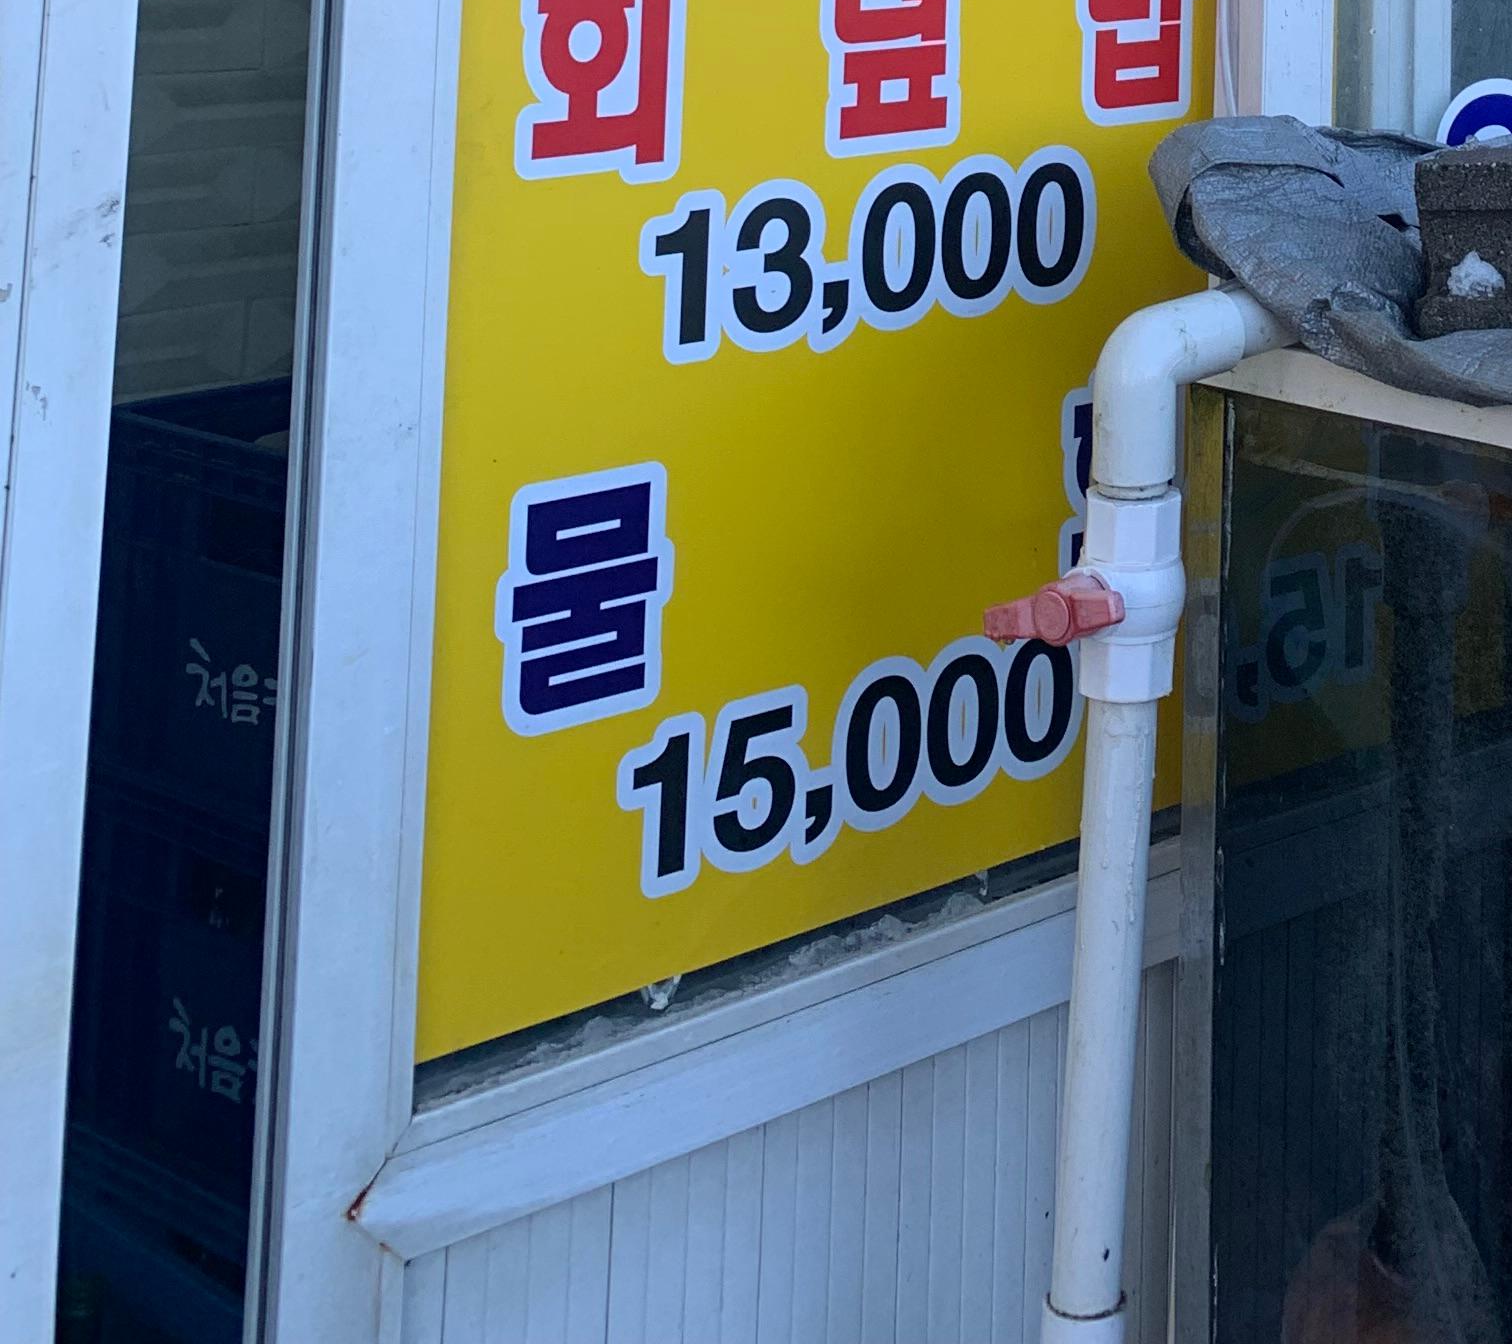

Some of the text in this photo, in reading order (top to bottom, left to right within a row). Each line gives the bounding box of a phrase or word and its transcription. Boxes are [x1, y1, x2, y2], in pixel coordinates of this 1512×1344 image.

[655, 162, 1085, 346] 13,000
[186, 637, 278, 726] 처음
[632, 639, 1075, 878] 15,000
[169, 997, 259, 1104] 처음
